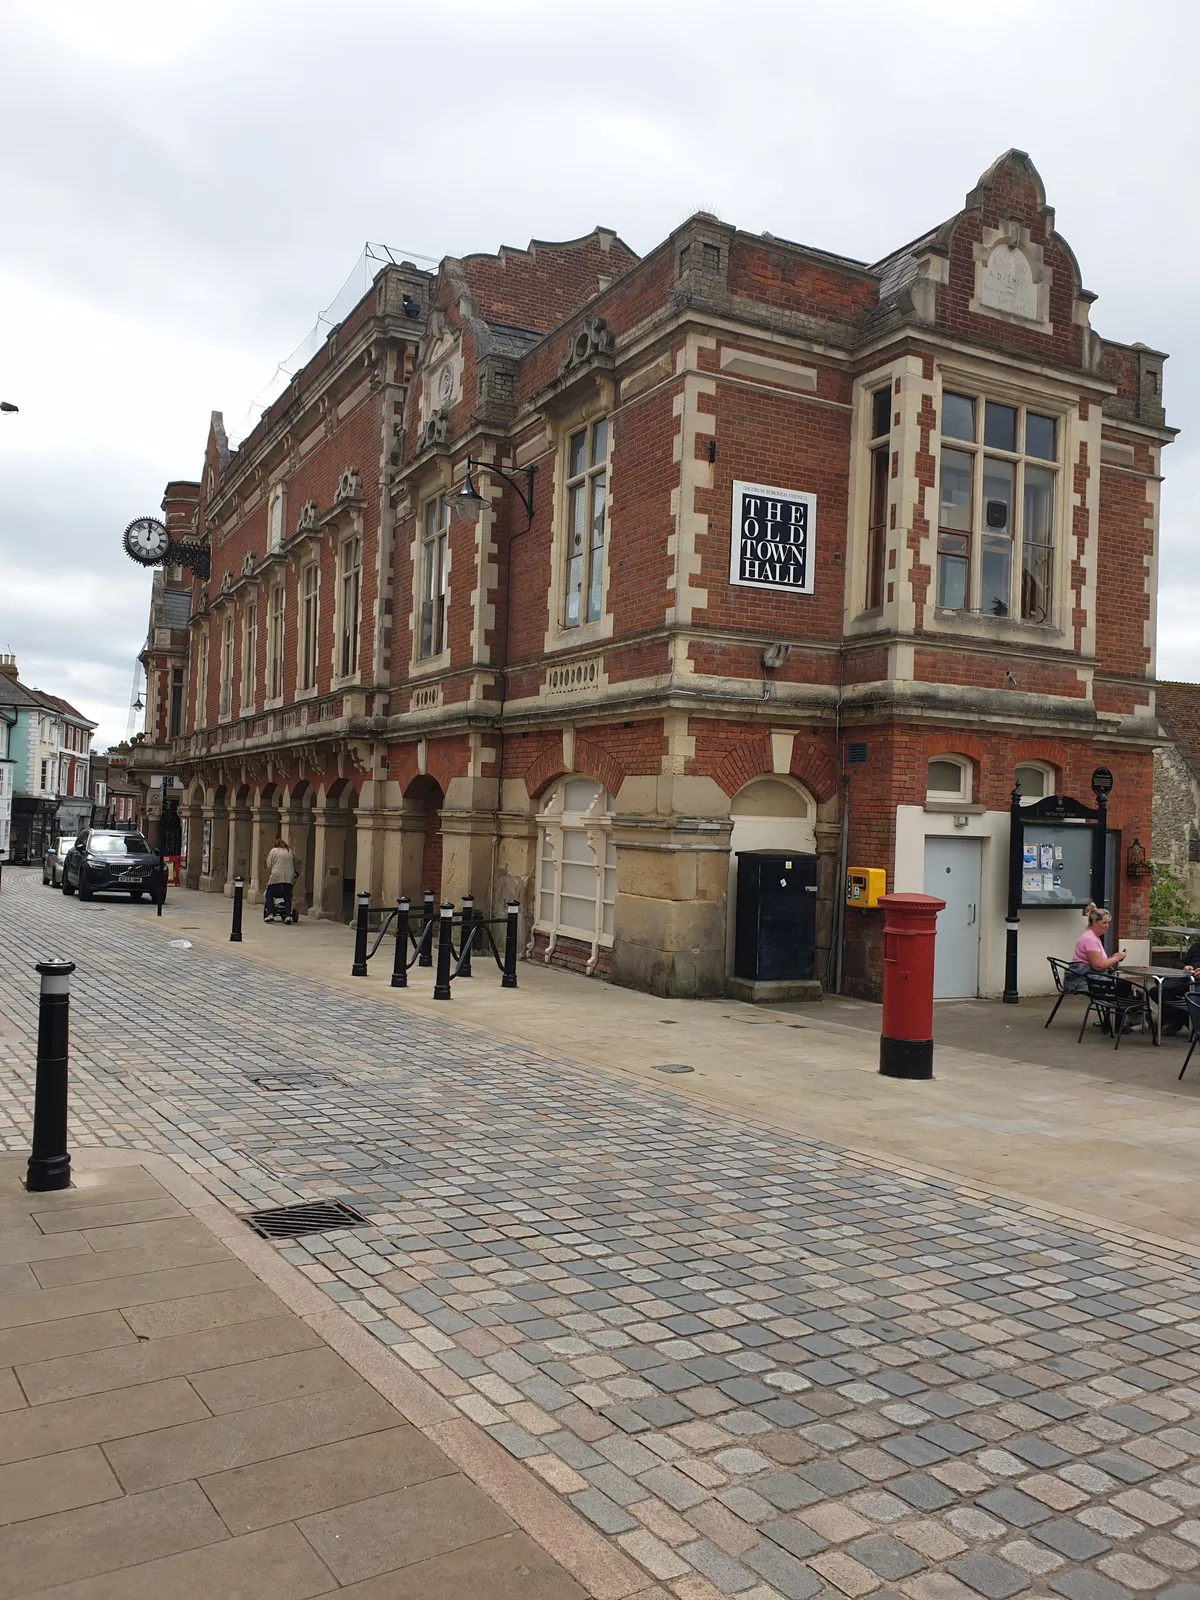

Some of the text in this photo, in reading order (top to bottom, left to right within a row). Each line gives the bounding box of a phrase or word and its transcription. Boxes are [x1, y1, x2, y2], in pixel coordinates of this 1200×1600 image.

[743, 486, 808, 501] DACORUM BOROUGH COUNCIL
[745, 498, 804, 525] THE
[744, 518, 804, 545] OLD
[742, 538, 805, 565] TOWN
[743, 558, 802, 585] HALL
